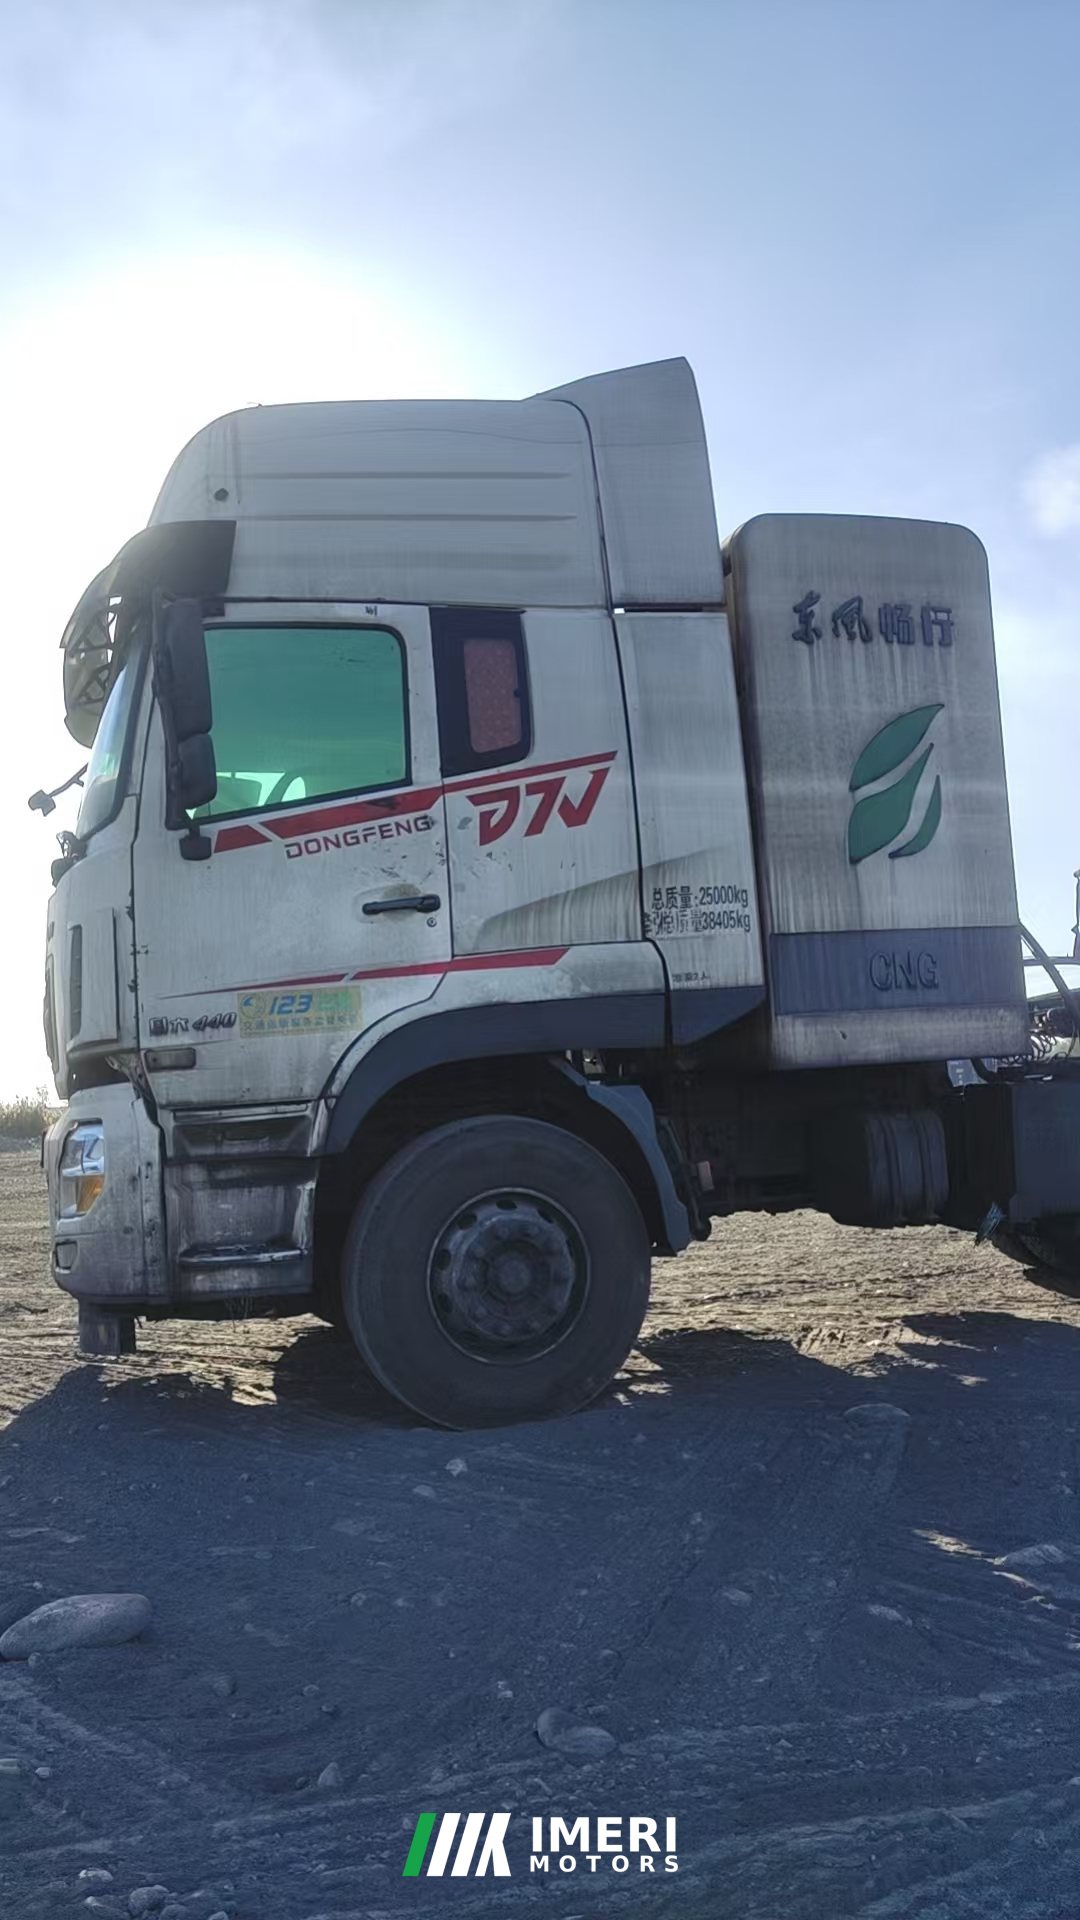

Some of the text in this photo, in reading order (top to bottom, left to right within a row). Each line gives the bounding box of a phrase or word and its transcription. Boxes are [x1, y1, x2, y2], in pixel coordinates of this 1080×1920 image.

[285, 815, 432, 859] DONGFENG
[869, 951, 939, 991] CNG
[192, 1012, 237, 1032] 440
